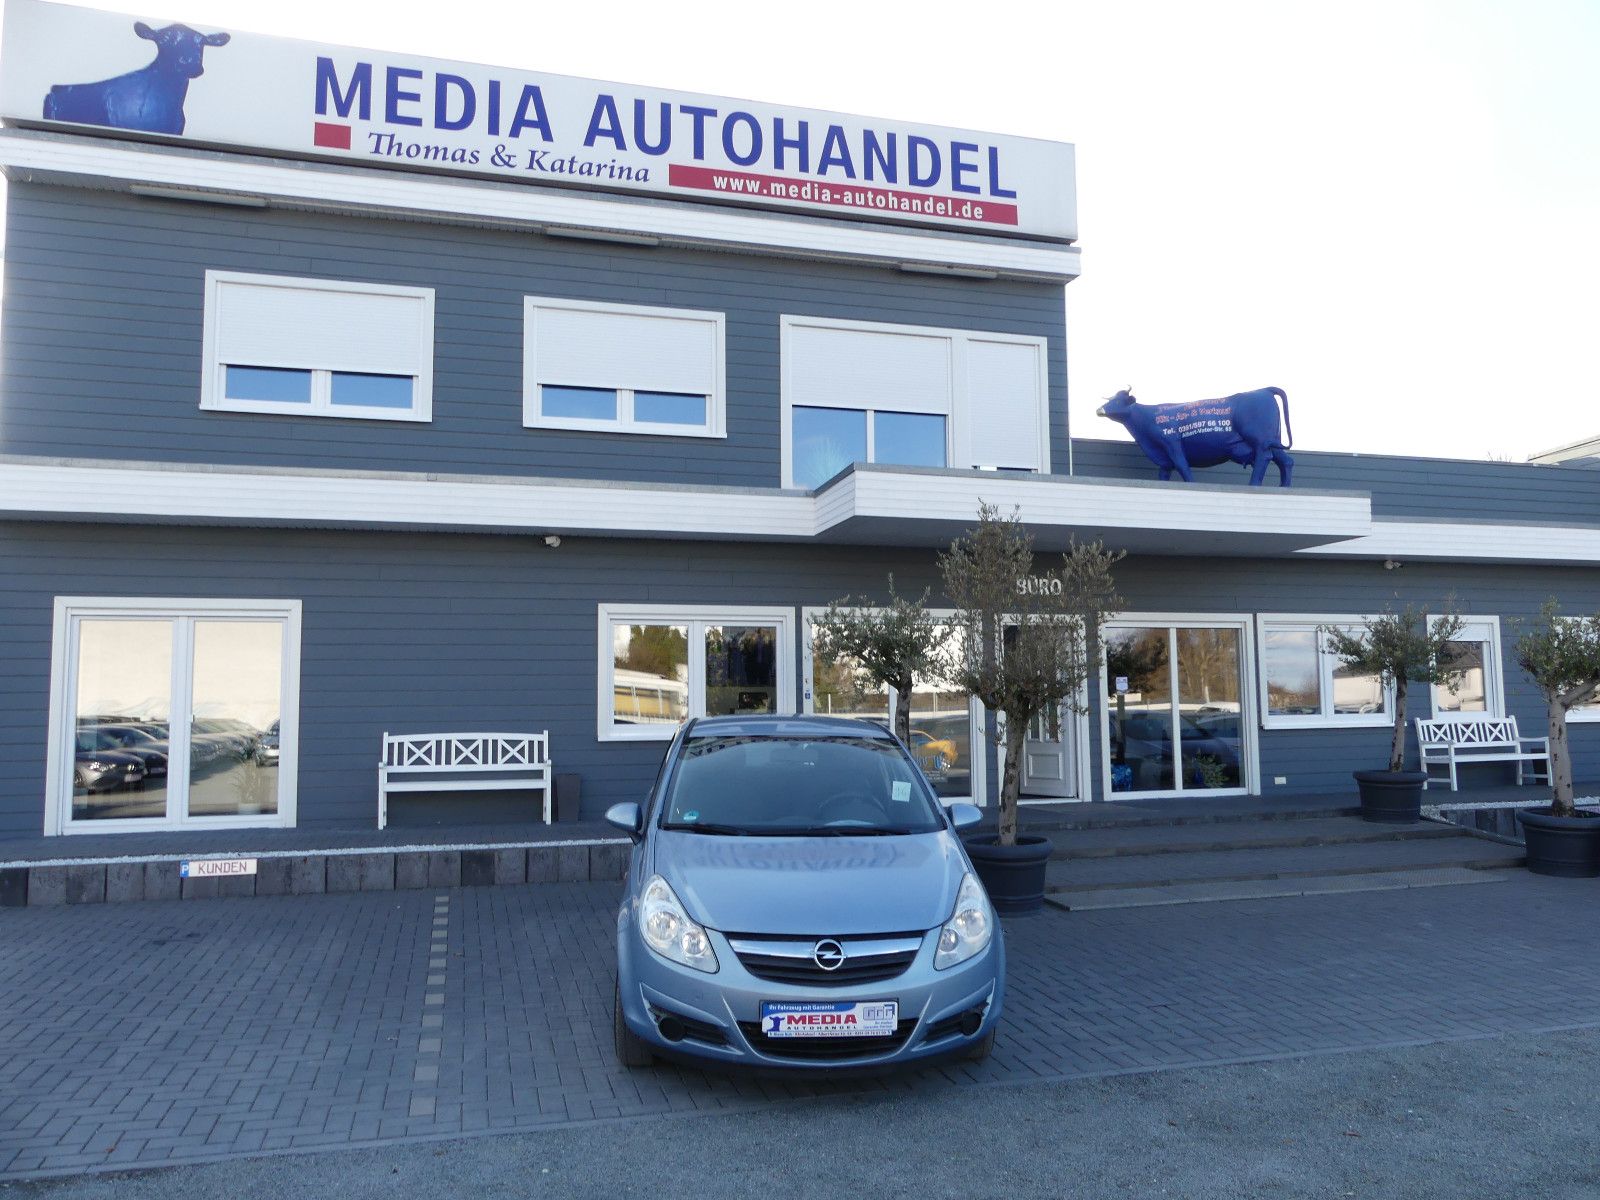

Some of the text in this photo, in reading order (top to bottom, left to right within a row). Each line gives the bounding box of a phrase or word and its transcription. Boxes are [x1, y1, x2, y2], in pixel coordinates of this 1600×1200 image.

[314, 56, 1017, 199] MEDIA AUTOHANDEL
[368, 132, 650, 183] Thomas & Katarina
[713, 174, 984, 219] www.media-autohandel.de
[181, 862, 247, 875] P KUNDEN
[786, 1014, 857, 1025] MEDIA
